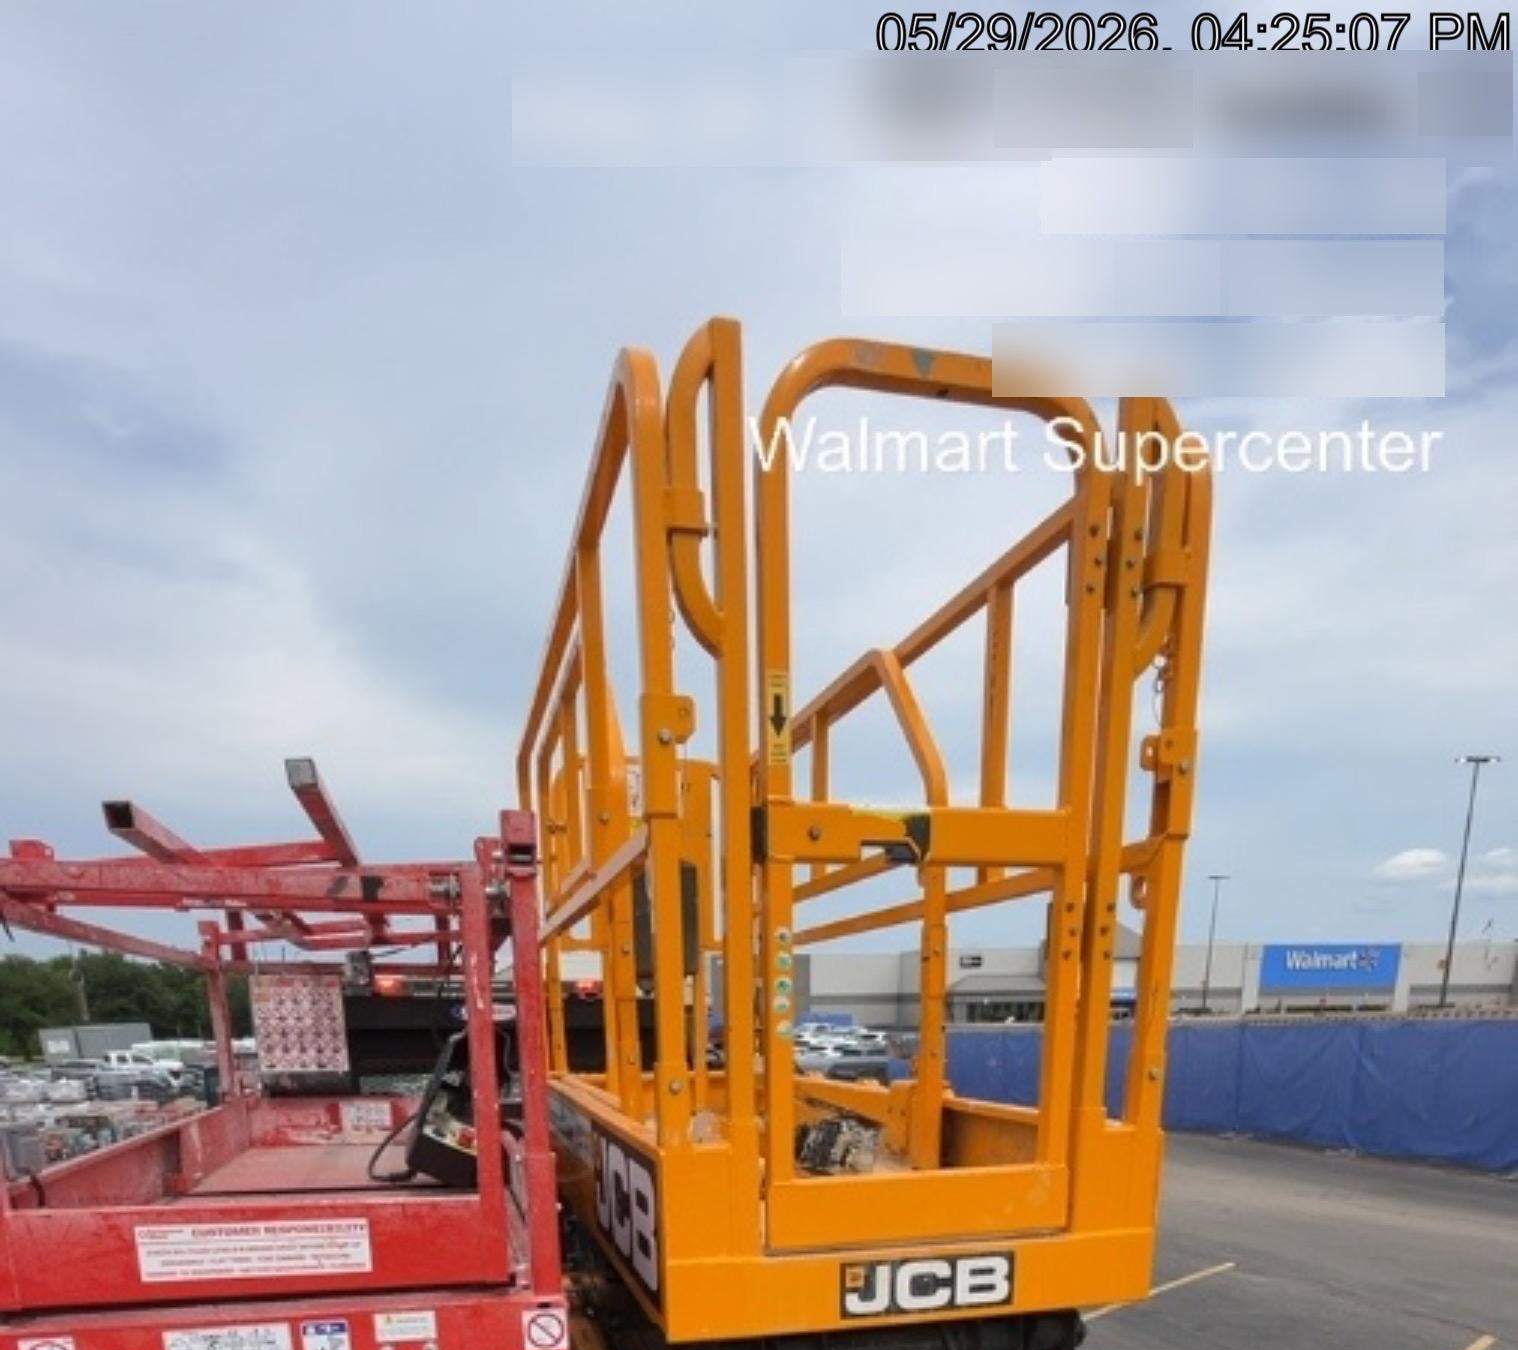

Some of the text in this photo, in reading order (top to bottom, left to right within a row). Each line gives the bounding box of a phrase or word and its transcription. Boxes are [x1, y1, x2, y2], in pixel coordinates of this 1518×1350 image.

[1286, 950, 1357, 970] Walmart
[597, 1137, 658, 1291] JCB
[845, 1256, 1009, 1314] JCB
